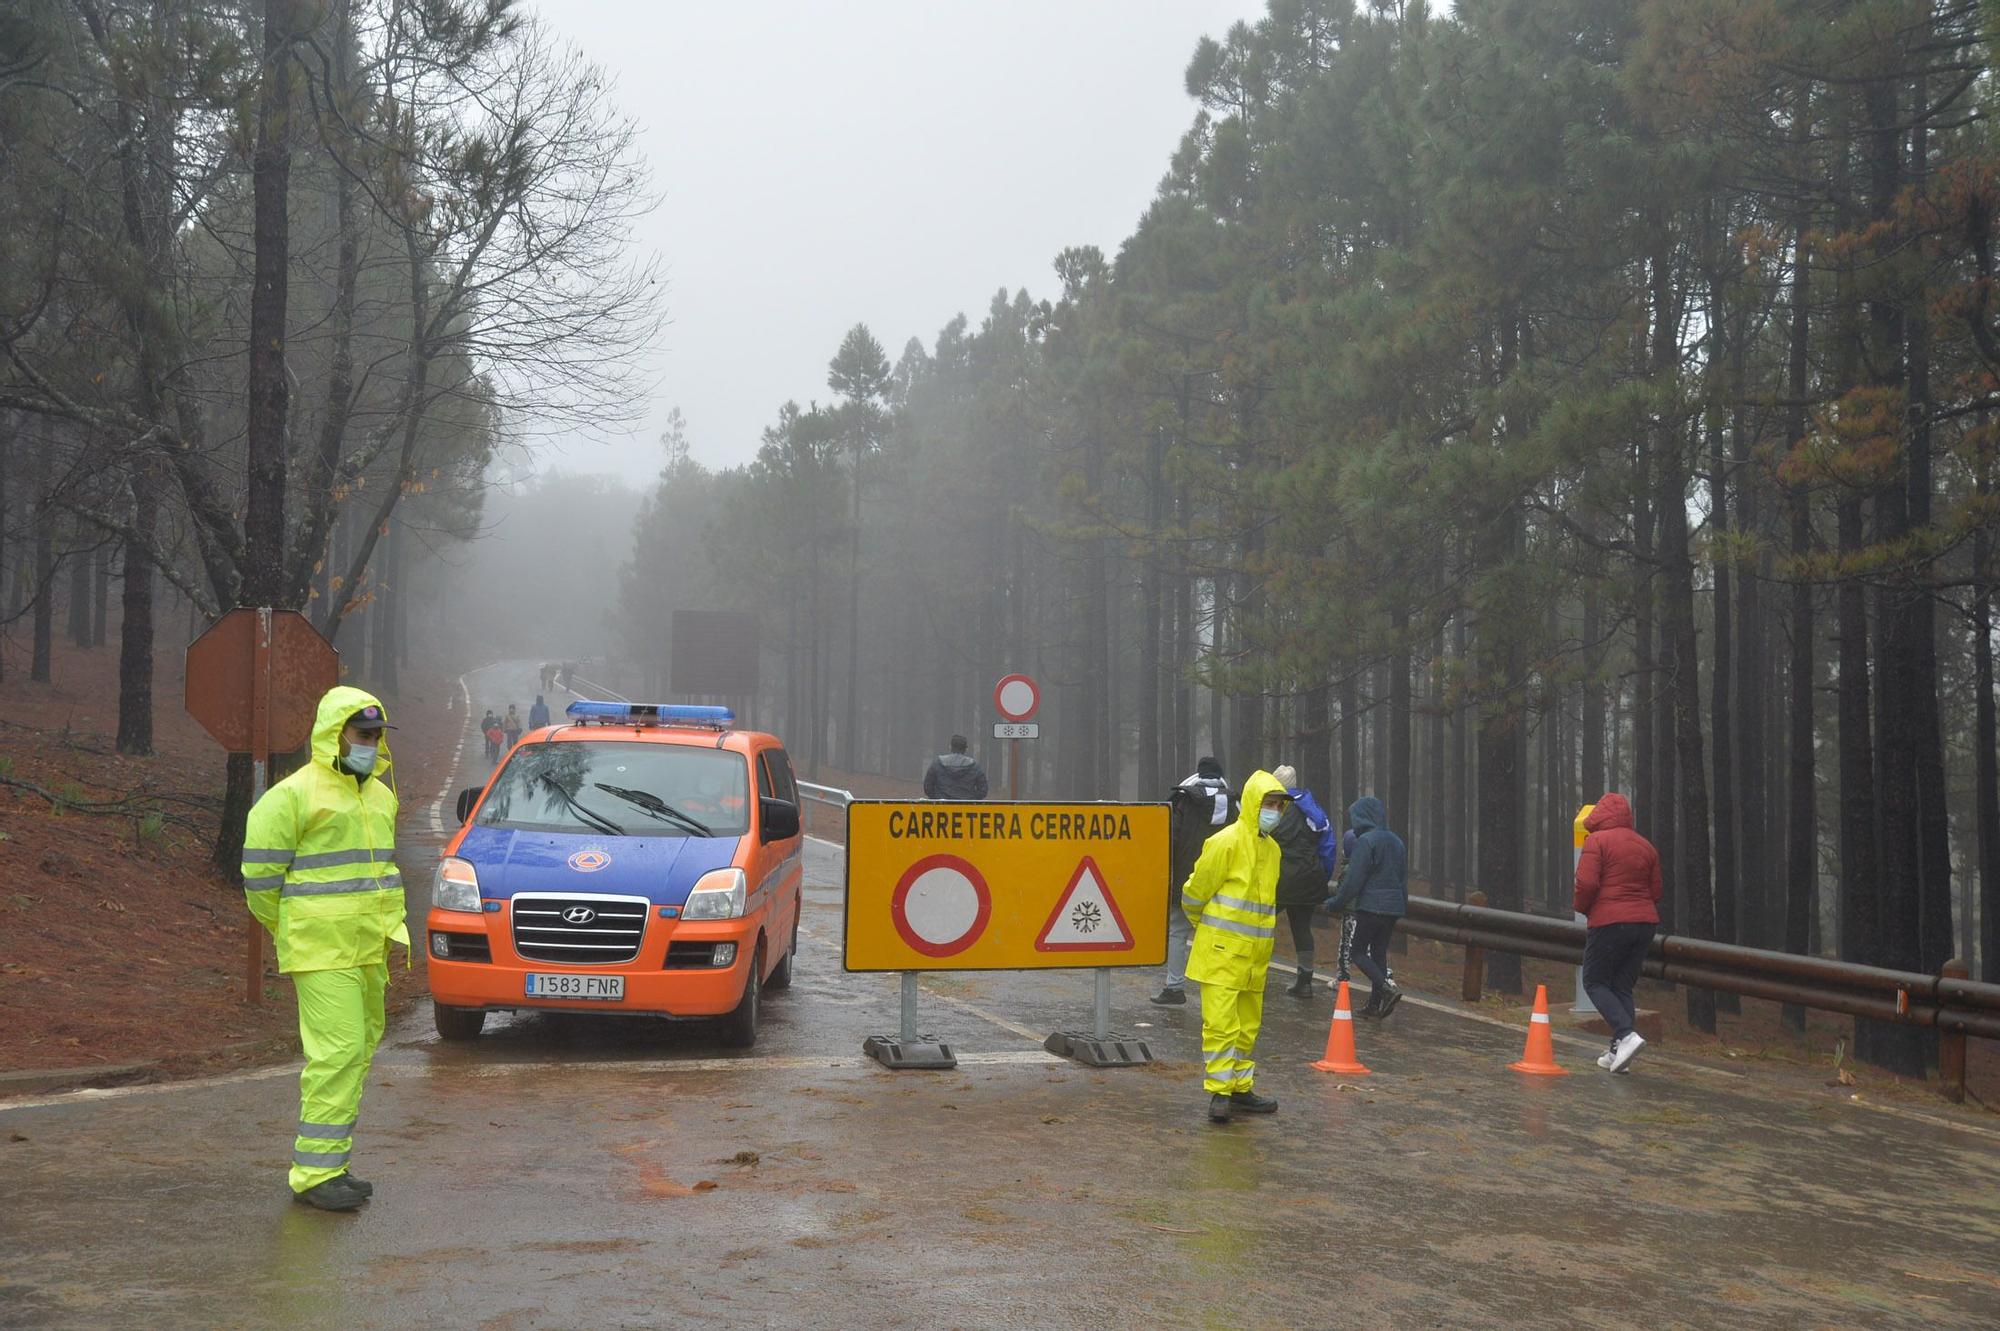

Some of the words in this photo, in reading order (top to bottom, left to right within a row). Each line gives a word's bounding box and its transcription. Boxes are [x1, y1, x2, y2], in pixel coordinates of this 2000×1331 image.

[889, 810, 1022, 840] CARRETERA
[1030, 812, 1132, 841] CERRADA
[539, 976, 581, 993] 1583
[586, 978, 619, 994] FNR
